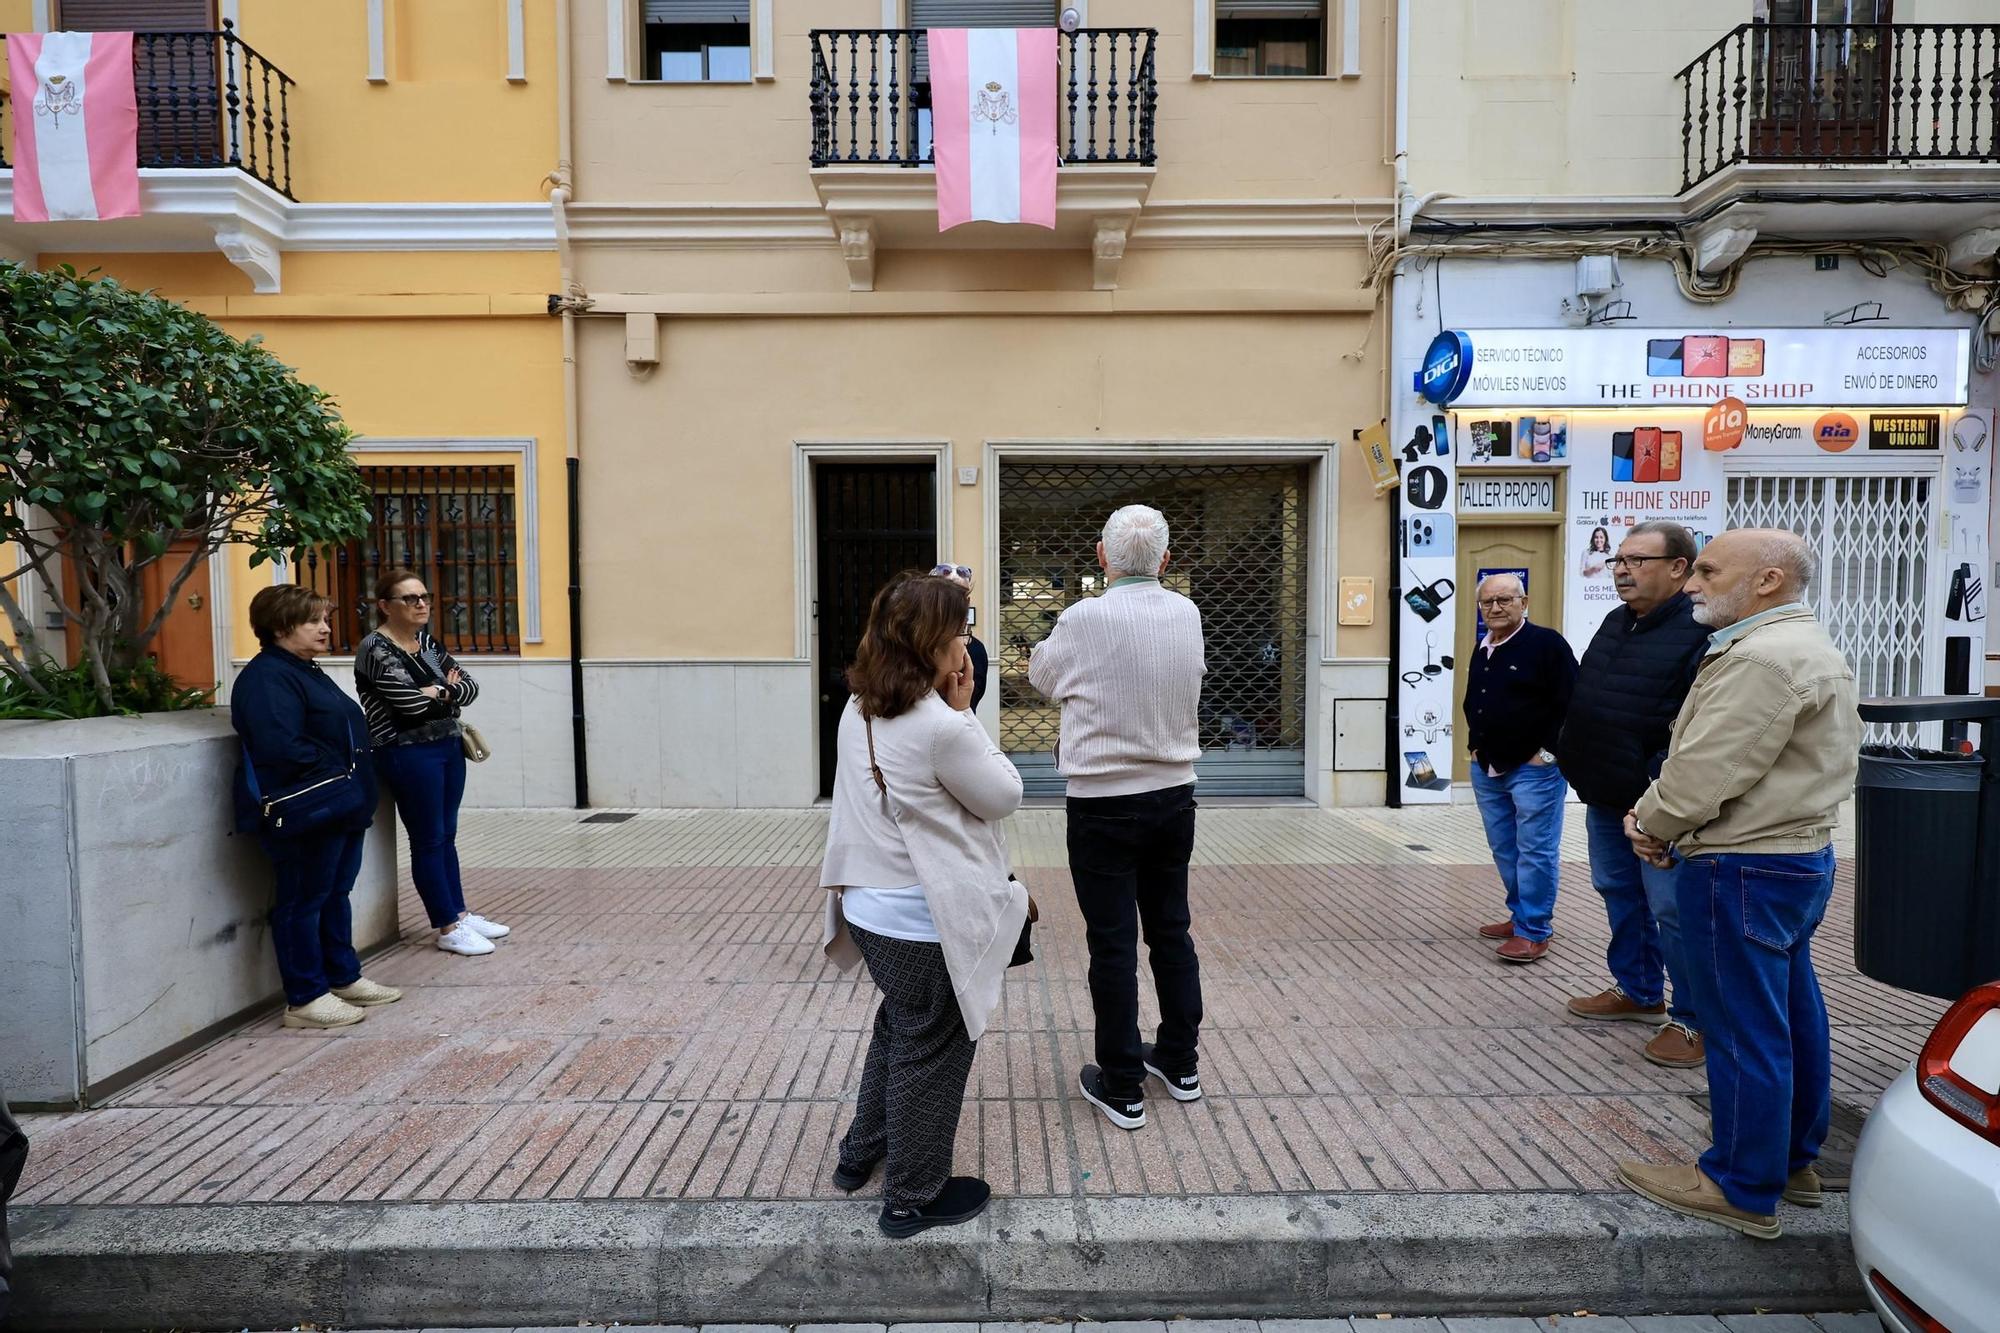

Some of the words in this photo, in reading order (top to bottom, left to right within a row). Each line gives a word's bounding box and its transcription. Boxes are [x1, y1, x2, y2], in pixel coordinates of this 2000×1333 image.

[1477, 348, 1520, 362] SERVICIO
[1523, 346, 1563, 362] TÉCNICO
[1857, 346, 1927, 360] ACCESORIOS
[1424, 353, 1458, 385] DIGI
[1473, 374, 1519, 391] MÓVILES
[1522, 376, 1566, 391] NUEVOS
[1844, 372, 1875, 389] ENVIÓ
[1879, 375, 1894, 389] DE
[1895, 375, 1938, 389] DINERO
[1598, 384, 1642, 398] THE
[1653, 384, 1735, 398] PHONE
[1746, 384, 1813, 398] SHOP
[1707, 404, 1742, 434] ria
[1873, 419, 1926, 432] WESTERN
[1745, 423, 1801, 444] MoneyGram
[1821, 423, 1851, 437] Ria
[1889, 432, 1925, 445] UNION
[1458, 482, 1501, 507] TALLER
[1504, 482, 1551, 507] PROPIO
[1582, 491, 1609, 510] THE
[1614, 491, 1663, 510] PHONE
[1669, 491, 1711, 510] SHOP
[1584, 585, 1601, 593] LOS
[1602, 585, 1617, 593] ME
